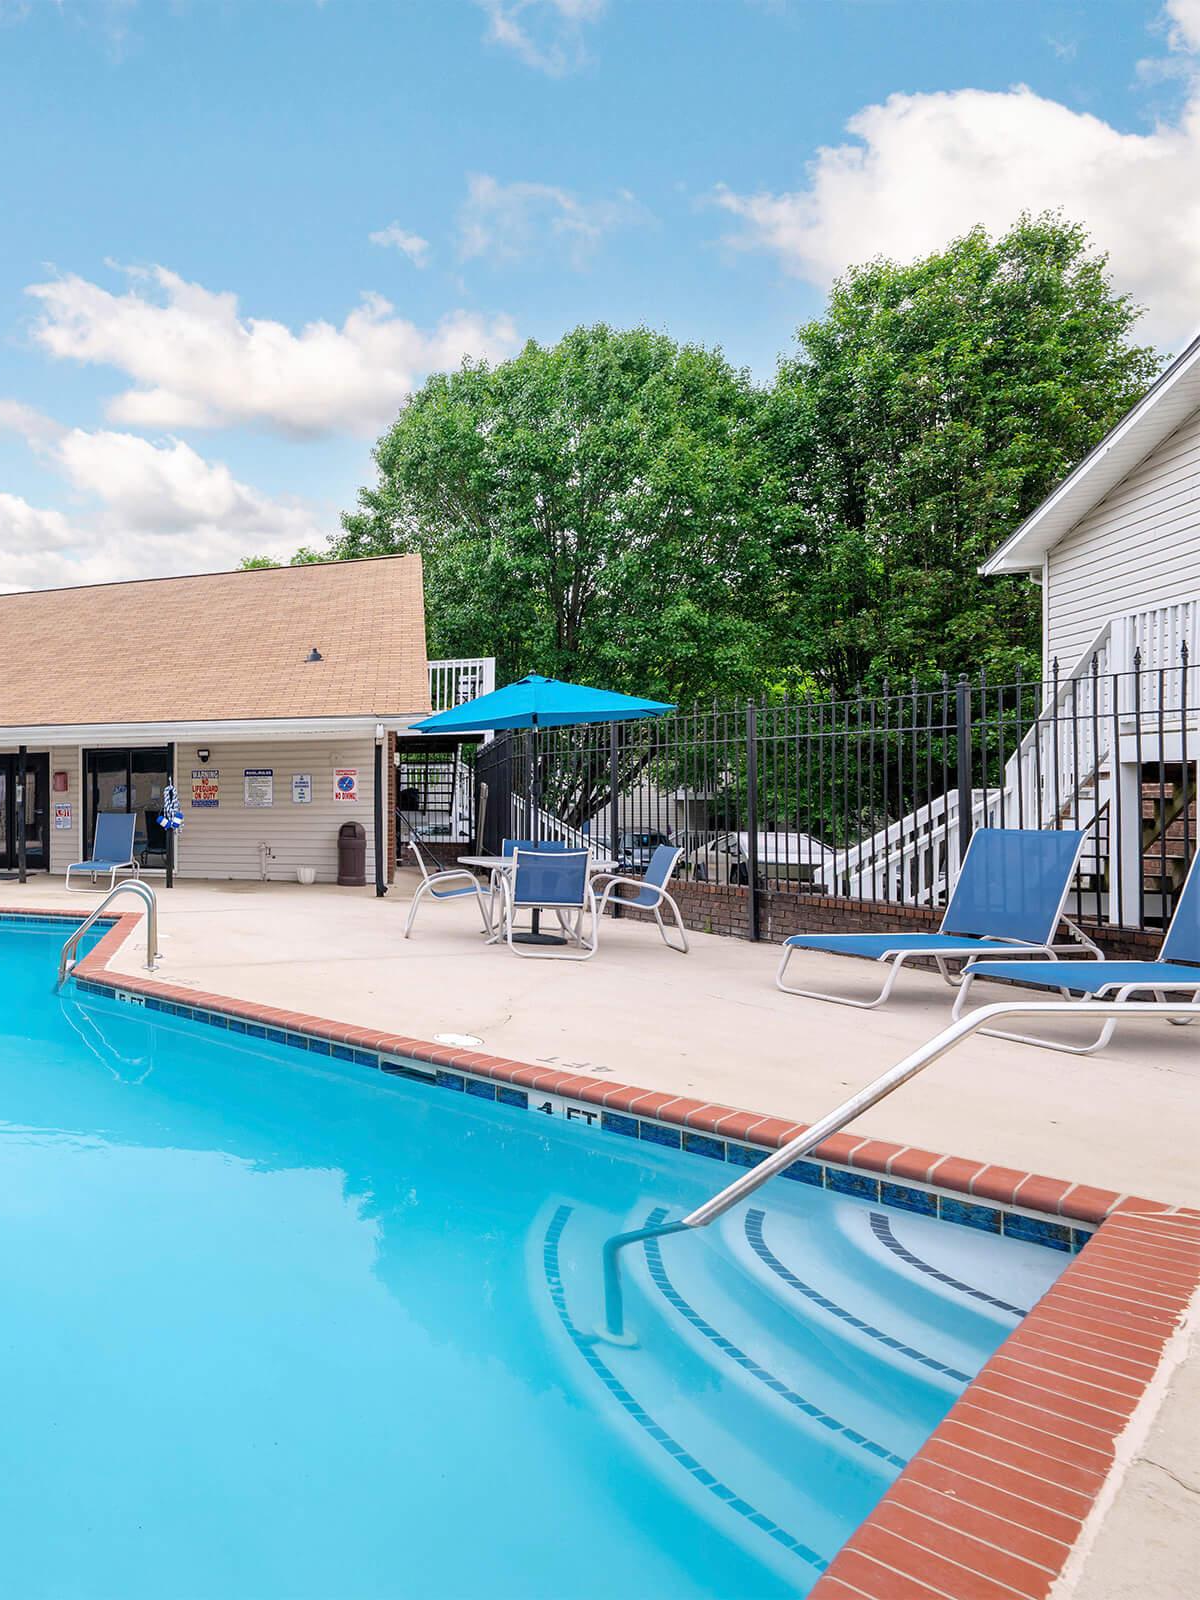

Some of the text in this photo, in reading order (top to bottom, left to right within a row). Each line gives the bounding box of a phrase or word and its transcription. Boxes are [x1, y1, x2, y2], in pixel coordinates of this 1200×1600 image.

[203, 792, 215, 800] DUTY
[336, 792, 341, 800] NO
[131, 996, 144, 1006] FT
[537, 1101, 598, 1125] 4 FT
